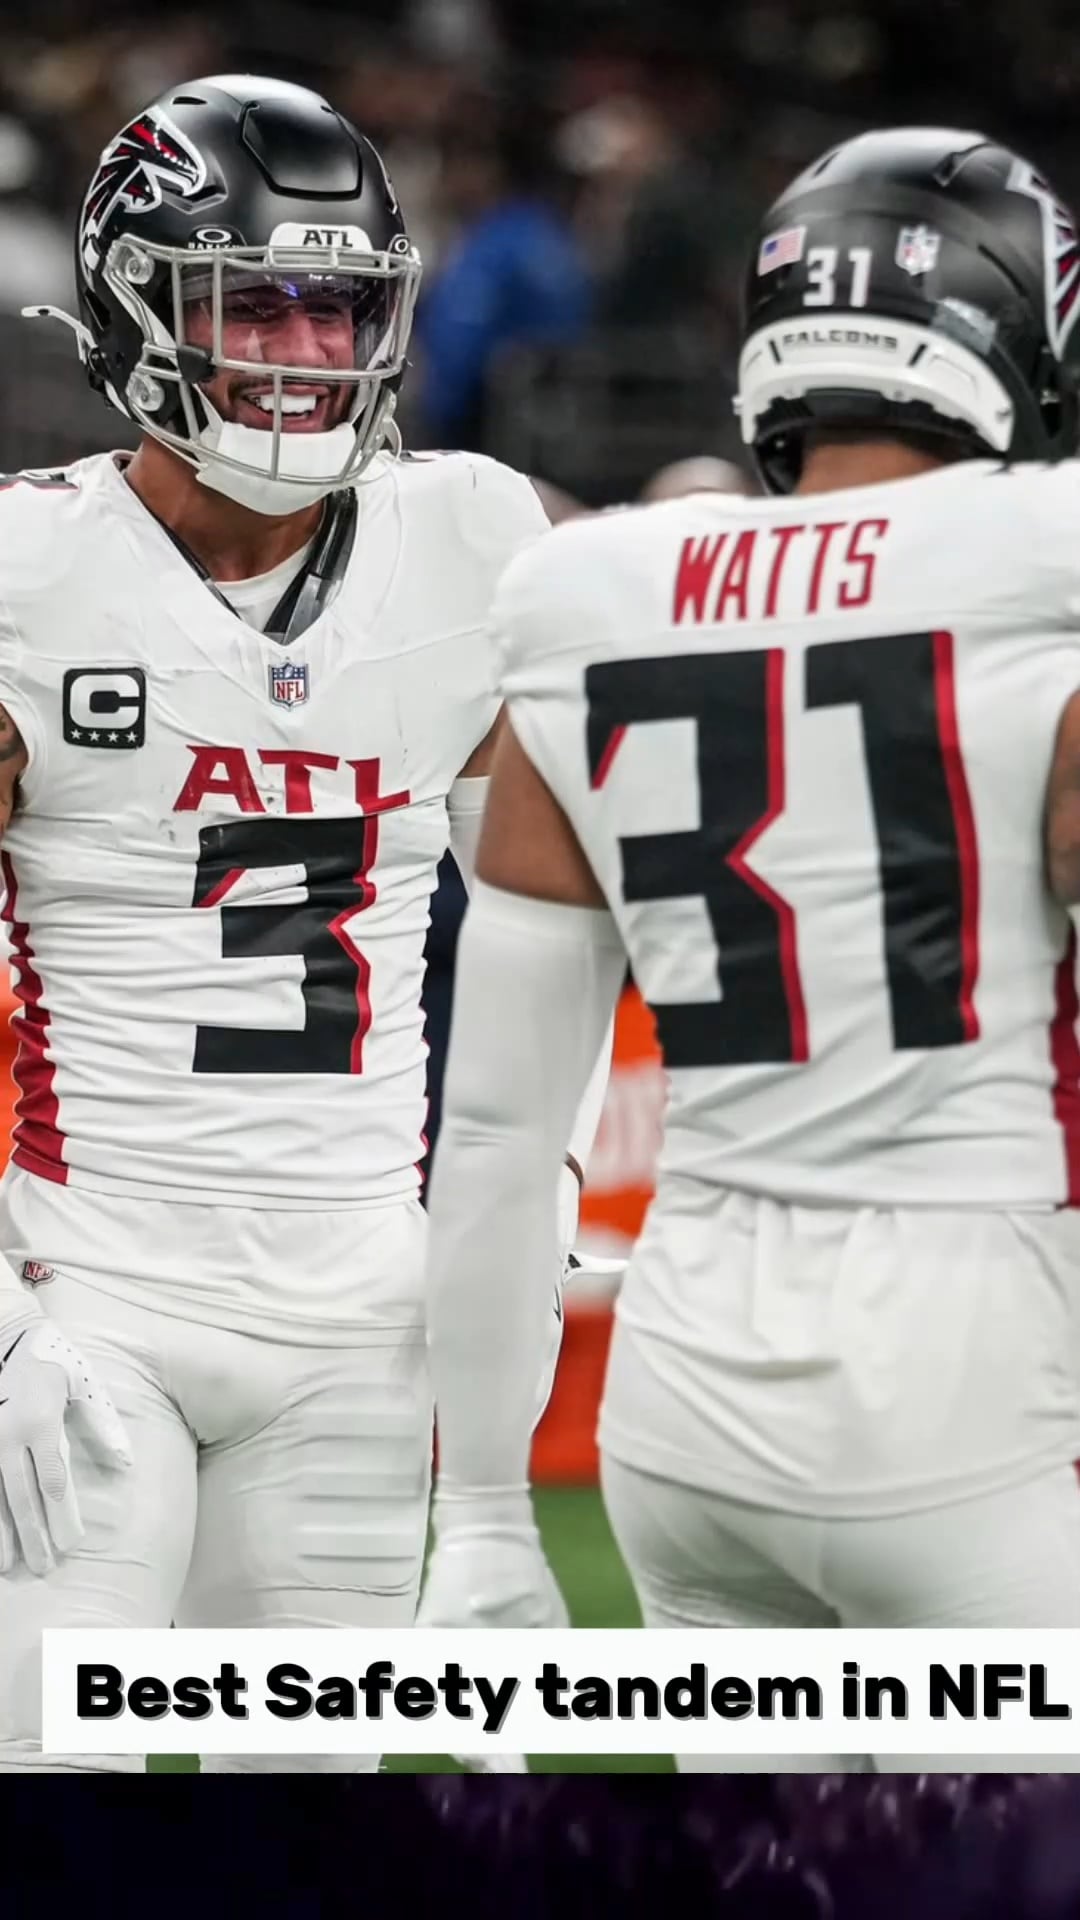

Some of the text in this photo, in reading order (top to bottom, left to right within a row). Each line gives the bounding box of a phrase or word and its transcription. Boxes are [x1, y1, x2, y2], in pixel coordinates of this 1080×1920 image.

[303, 229, 353, 248] ATL
[803, 247, 873, 308] 31
[782, 329, 898, 350] FALCONS
[673, 519, 889, 624] WATTS
[69, 674, 140, 729] C
[276, 681, 304, 701] NFL
[173, 745, 411, 814] ATL
[584, 630, 982, 1068] 31
[192, 815, 377, 1075] 3
[26, 1261, 50, 1279] NFL
